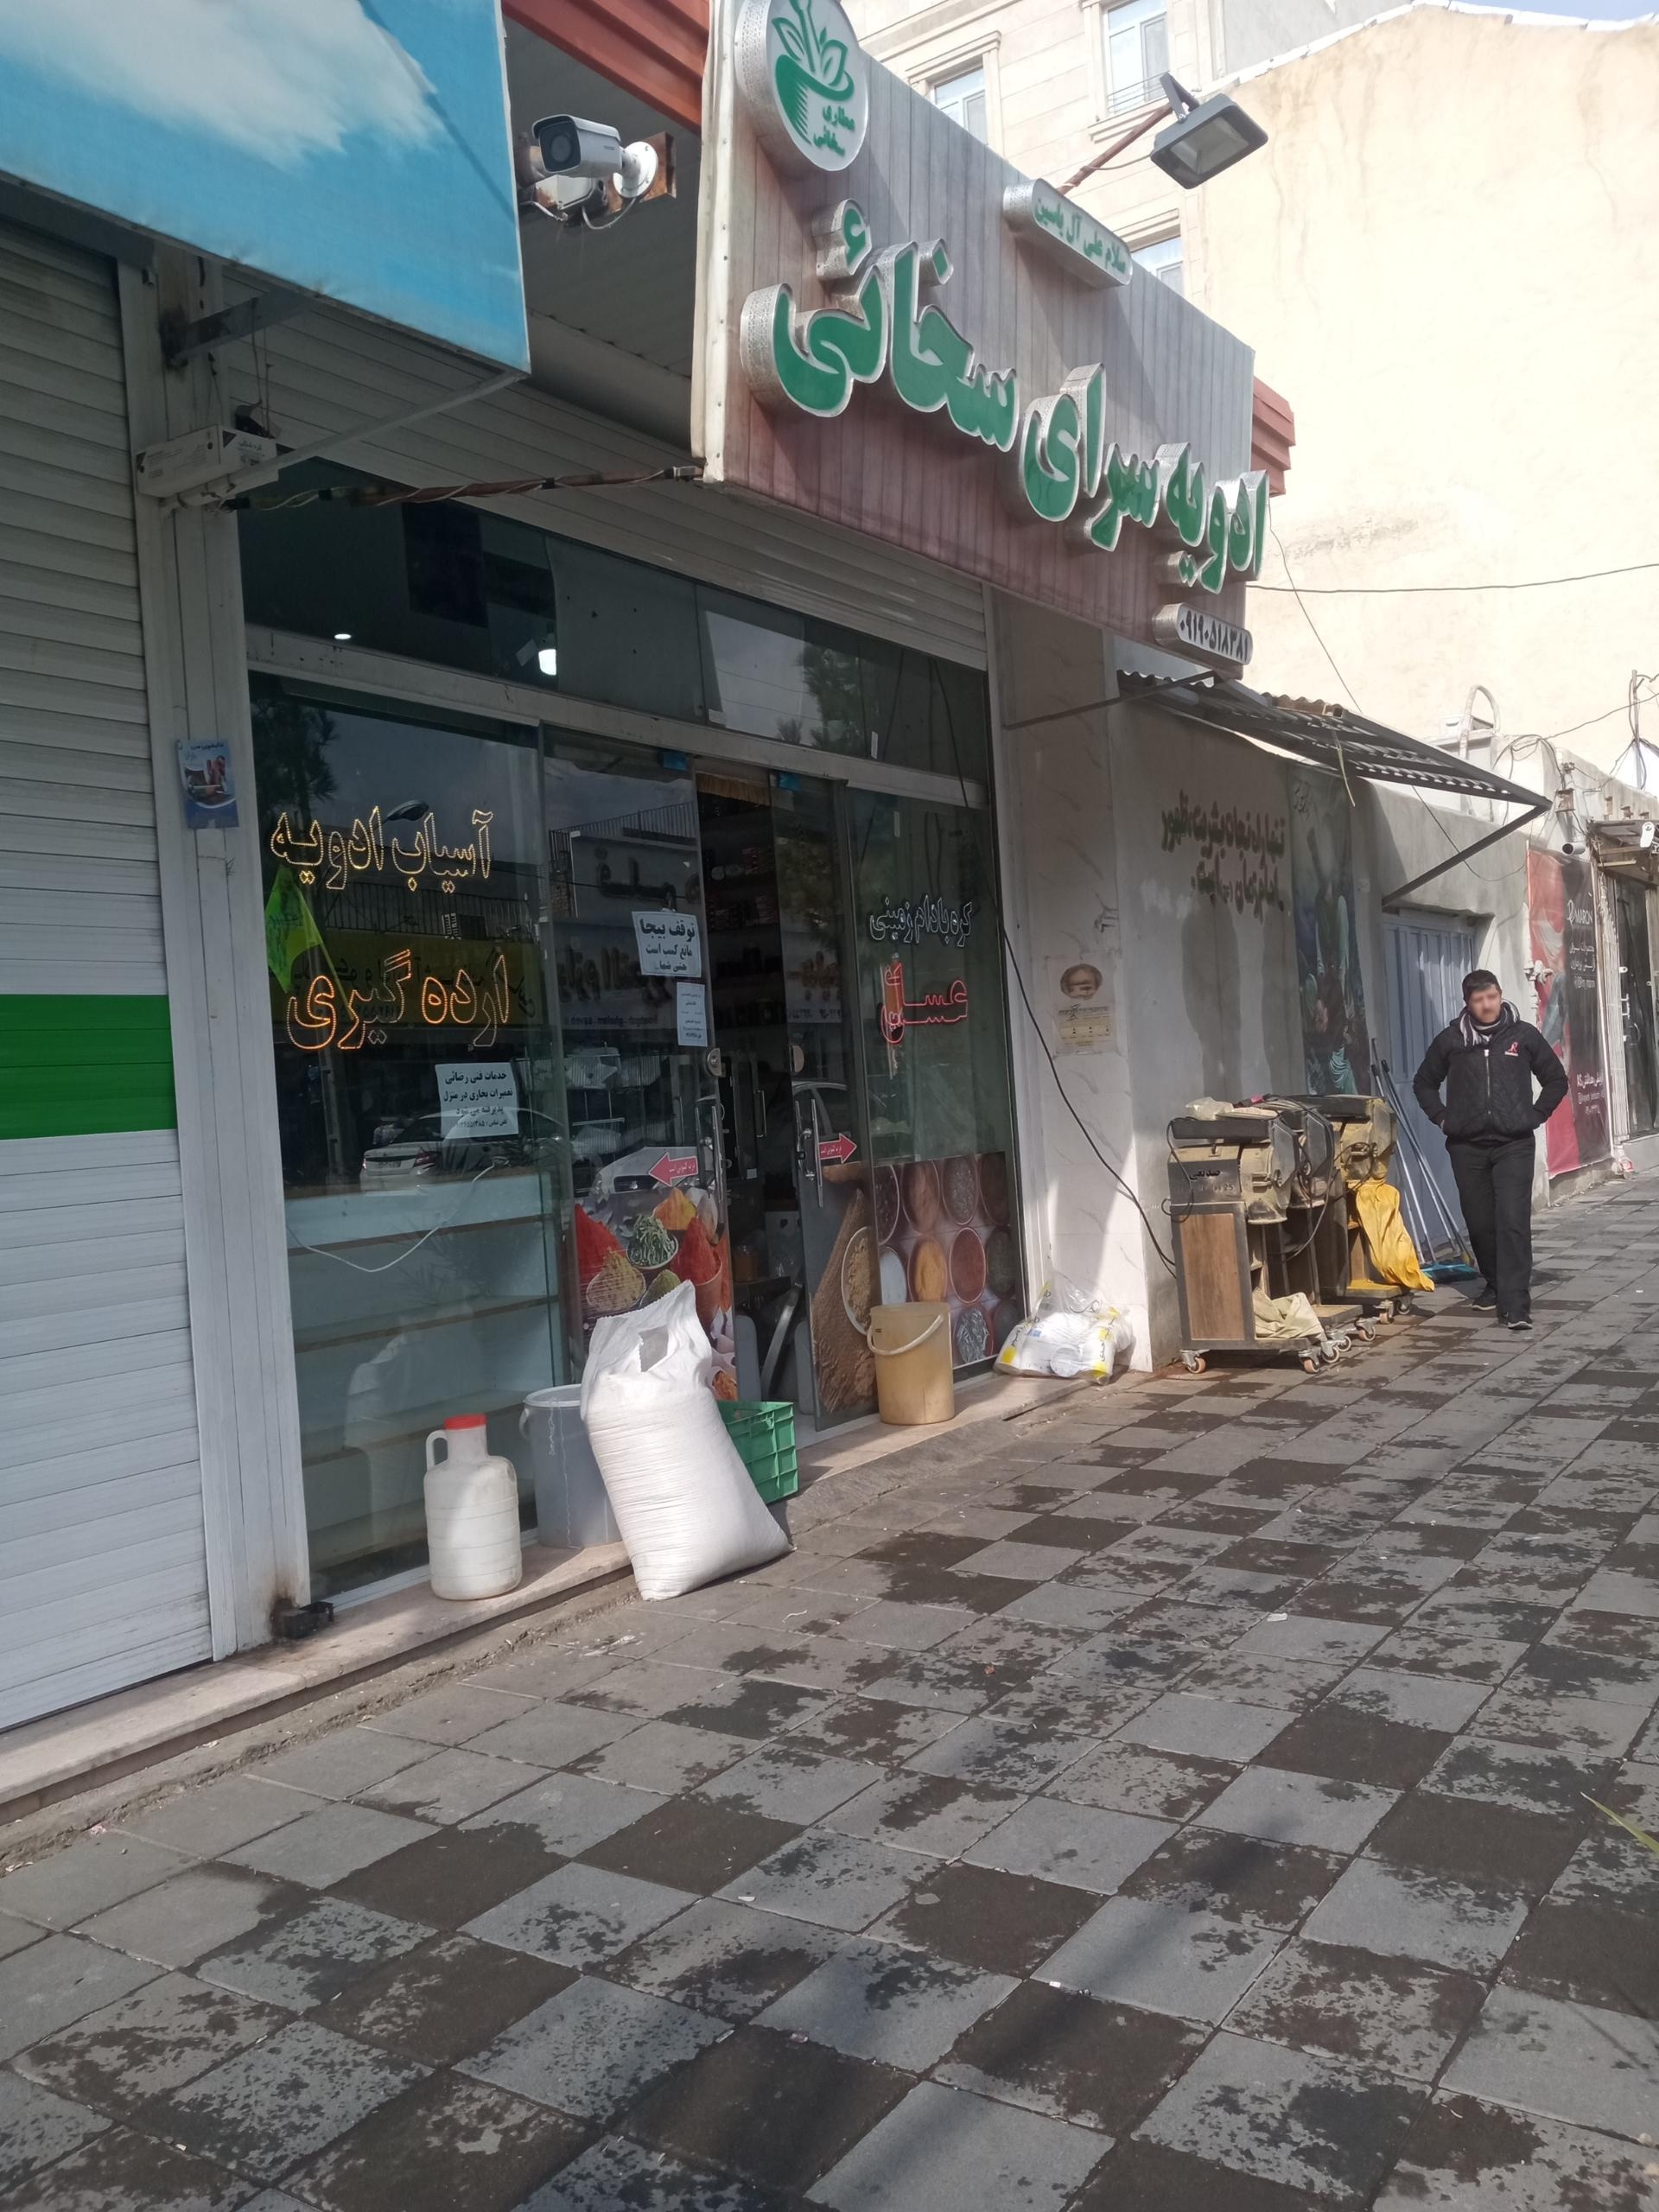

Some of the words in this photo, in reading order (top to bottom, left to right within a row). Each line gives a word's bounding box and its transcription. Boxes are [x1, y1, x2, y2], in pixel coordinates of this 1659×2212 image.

[1034, 198, 1065, 238] یاسین
[1065, 212, 1082, 245] آل
[1083, 229, 1103, 257] علی
[1104, 241, 1126, 274] سلام
[1022, 363, 1160, 551] سرای
[1163, 442, 1268, 594] ادویه
[270, 805, 385, 890] ادویه
[391, 809, 494, 893] آسیاب
[639, 918, 665, 939] بیجا
[669, 919, 696, 943] توقف
[869, 896, 913, 943] زمینی
[914, 894, 950, 944] بادام
[950, 901, 974, 948] کره
[645, 943, 661, 955] است
[663, 944, 678, 957] کسب
[679, 944, 692, 959] مانع
[286, 950, 412, 1050] گیری
[422, 954, 510, 1047] ارده
[880, 962, 969, 1044] عسل
[470, 1071, 483, 1084] فنی
[485, 1071, 507, 1081] خدمات
[443, 1090, 458, 1102] منزل
[460, 1091, 467, 1102] در
[469, 1089, 489, 1101] بخاری
[489, 1088, 513, 1099] تعمیرات
